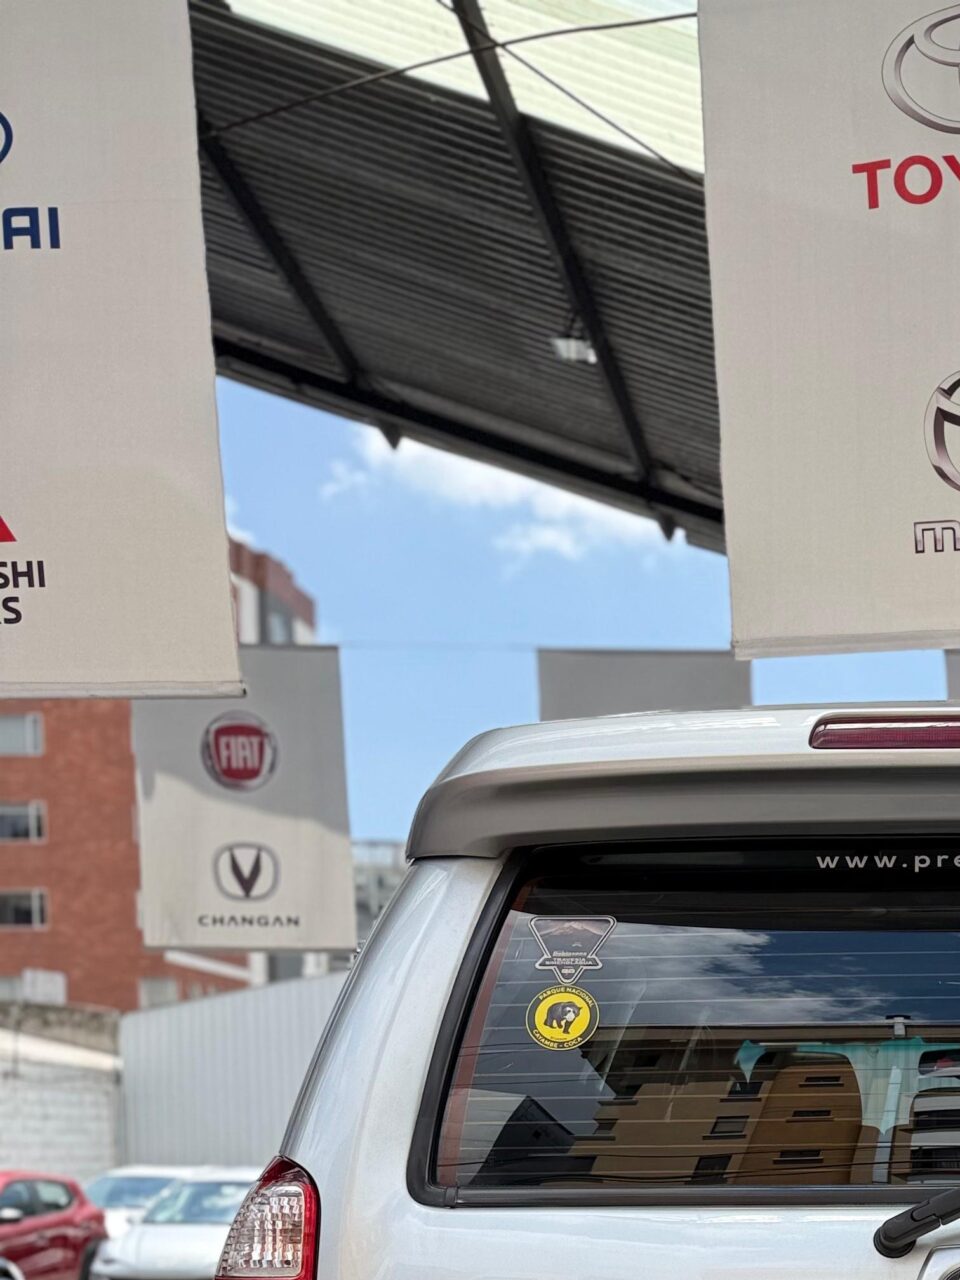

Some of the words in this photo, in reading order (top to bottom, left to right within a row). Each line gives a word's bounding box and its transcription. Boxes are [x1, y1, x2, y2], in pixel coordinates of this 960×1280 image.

[218, 735, 264, 770] FIAT
[198, 914, 300, 928] CHANGAN
[539, 986, 566, 1000] PARQUE
[566, 986, 594, 1008] NACIONAL
[564, 1037, 583, 1048] COCA
